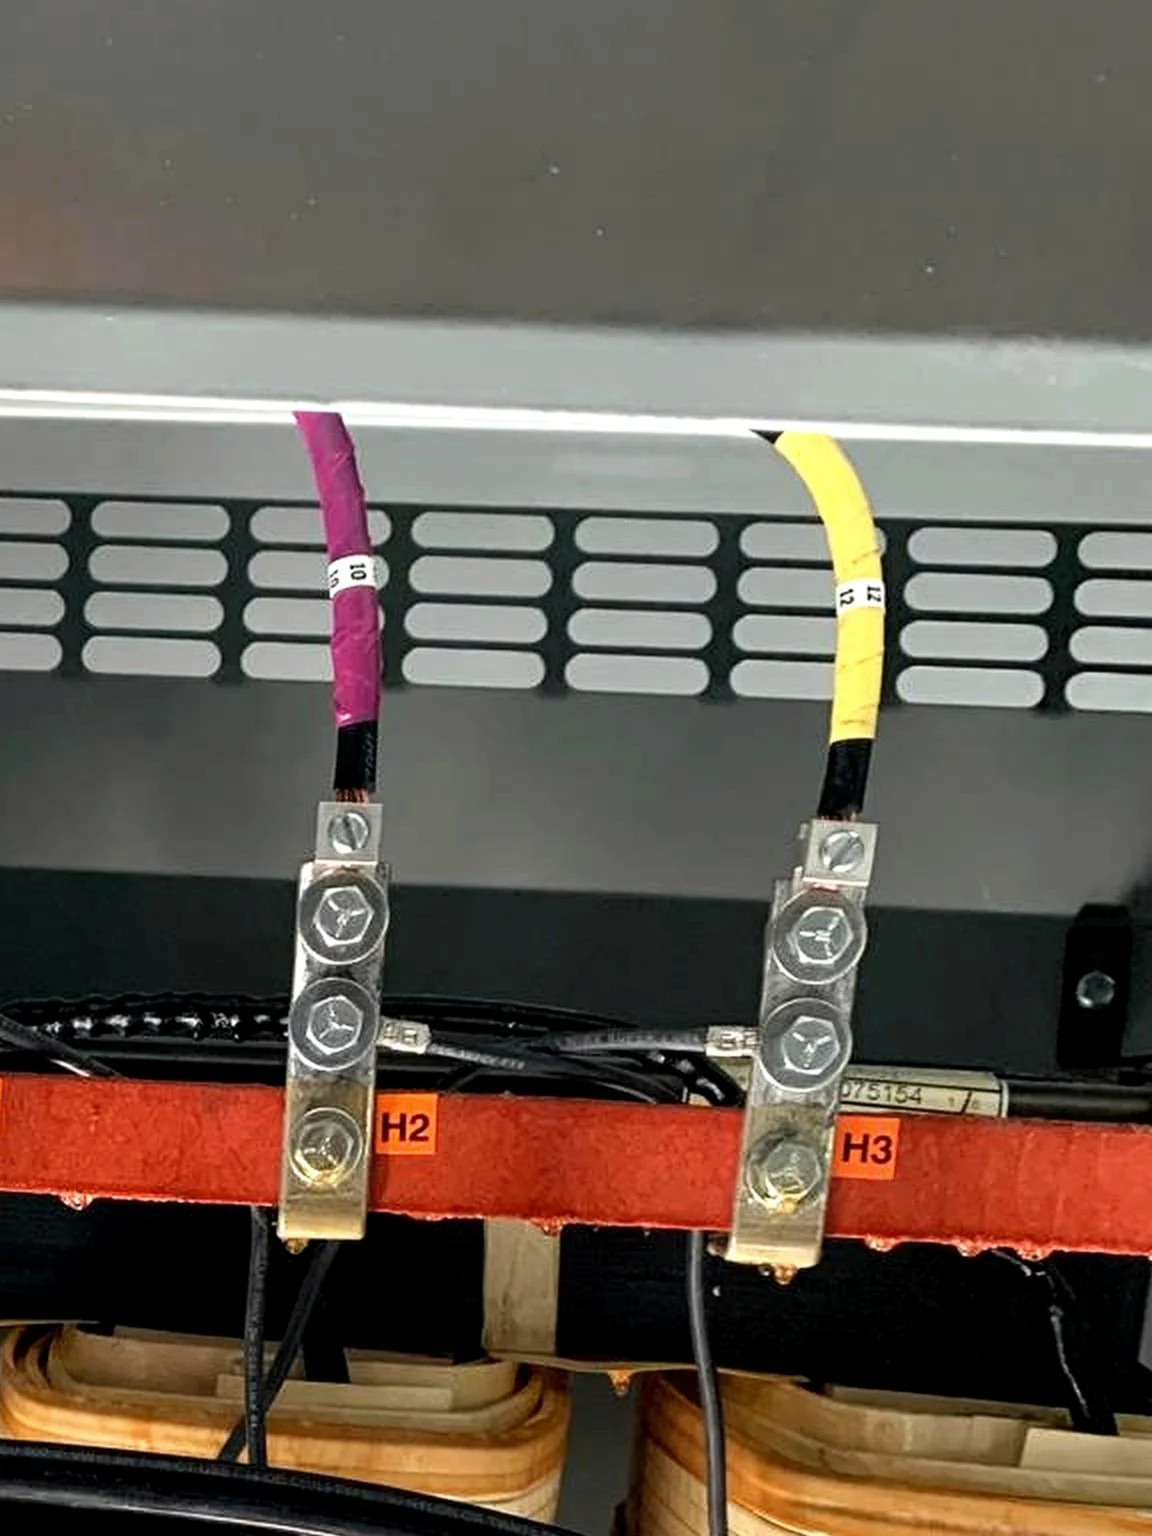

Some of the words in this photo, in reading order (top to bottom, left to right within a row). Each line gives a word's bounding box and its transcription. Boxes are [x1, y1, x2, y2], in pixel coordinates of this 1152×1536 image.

[349, 562, 368, 581] 10
[839, 587, 855, 608] 12
[381, 1112, 430, 1143] H2
[842, 1131, 892, 1165] H3
